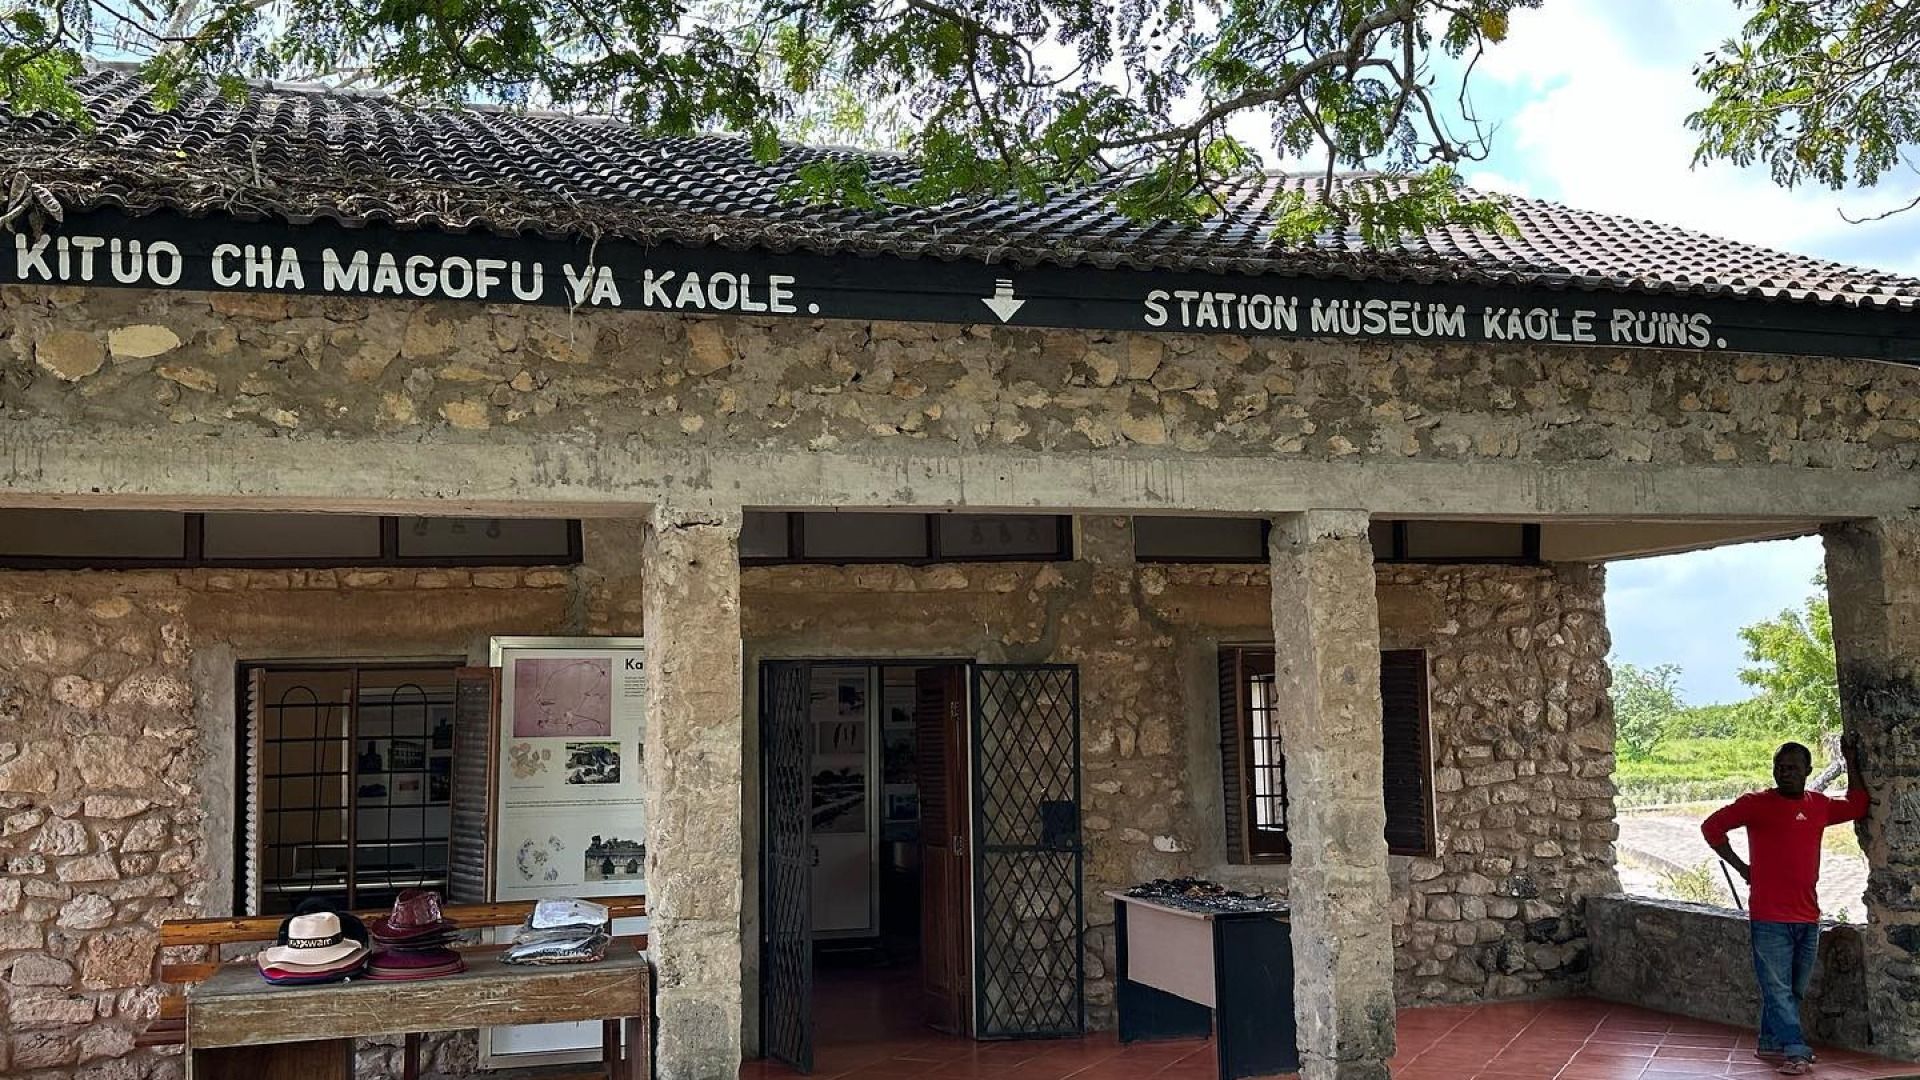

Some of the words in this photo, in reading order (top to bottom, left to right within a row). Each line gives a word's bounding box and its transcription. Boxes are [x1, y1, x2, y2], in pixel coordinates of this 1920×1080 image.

[16, 233, 182, 286] KITUO
[211, 243, 305, 290] CHA
[322, 248, 544, 301] MAGOFU
[563, 263, 621, 306] YA
[643, 270, 820, 314] KAOLE.
[1144, 289, 1298, 332] STATION
[1310, 298, 1466, 337] MUSEUM
[1483, 306, 1597, 343] KAOLE
[1610, 309, 1728, 348] RUINS.
